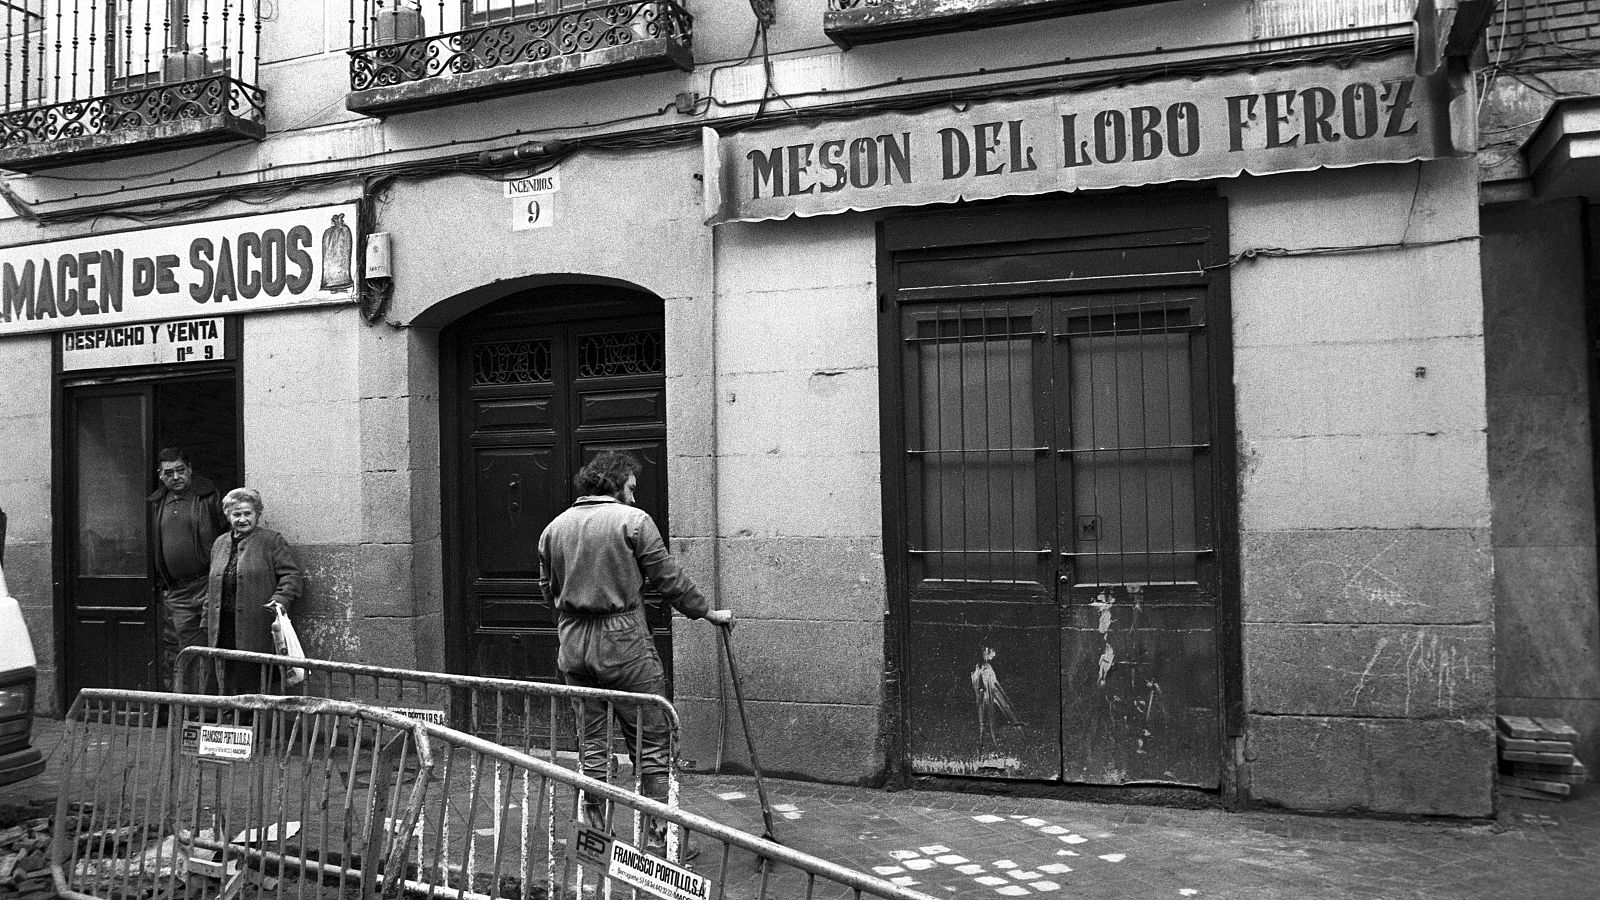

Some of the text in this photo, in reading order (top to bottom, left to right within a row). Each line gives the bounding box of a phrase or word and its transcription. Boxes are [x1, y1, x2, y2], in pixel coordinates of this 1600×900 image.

[747, 79, 1419, 199] MESON DEL LOBO FEROZ
[509, 177, 553, 194] INCENDIOS
[527, 200, 540, 223] 9
[0, 224, 313, 322] MACEN DE SACOS
[65, 320, 218, 351] DESPACHO Y VENTA
[204, 345, 214, 359] 9
[613, 845, 654, 876] FRANCISCO
